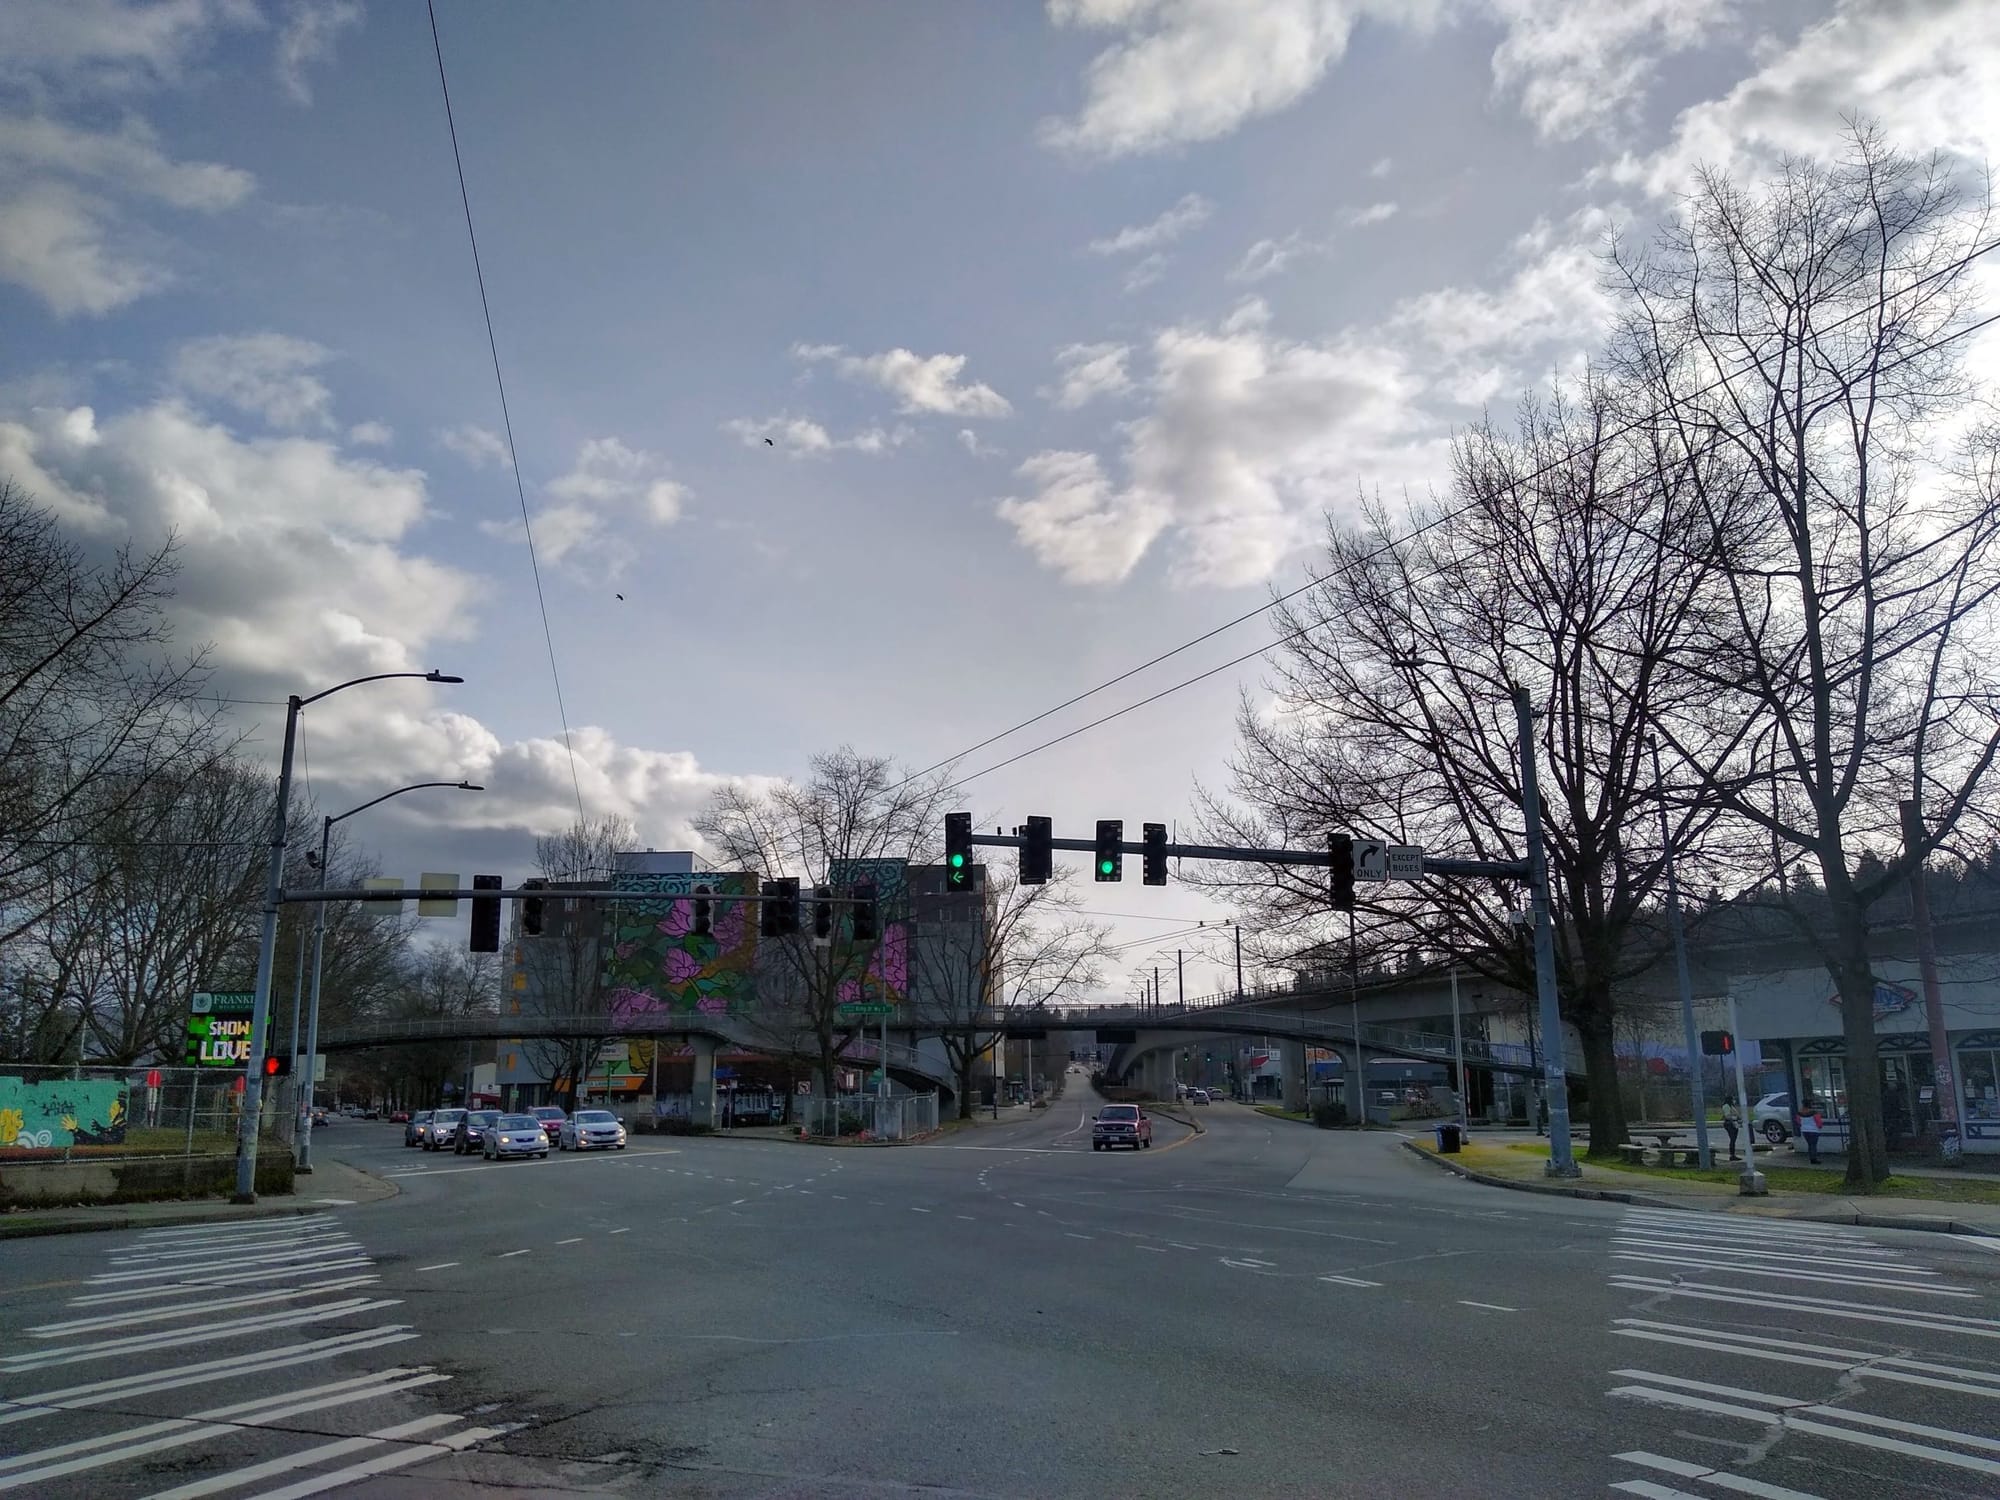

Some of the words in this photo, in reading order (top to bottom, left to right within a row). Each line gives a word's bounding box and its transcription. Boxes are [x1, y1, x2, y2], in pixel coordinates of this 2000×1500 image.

[1357, 869, 1381, 878] ONLY
[213, 994, 254, 1004] FRANKL
[209, 1021, 249, 1035] SHOW
[200, 1041, 251, 1060] LOVE
